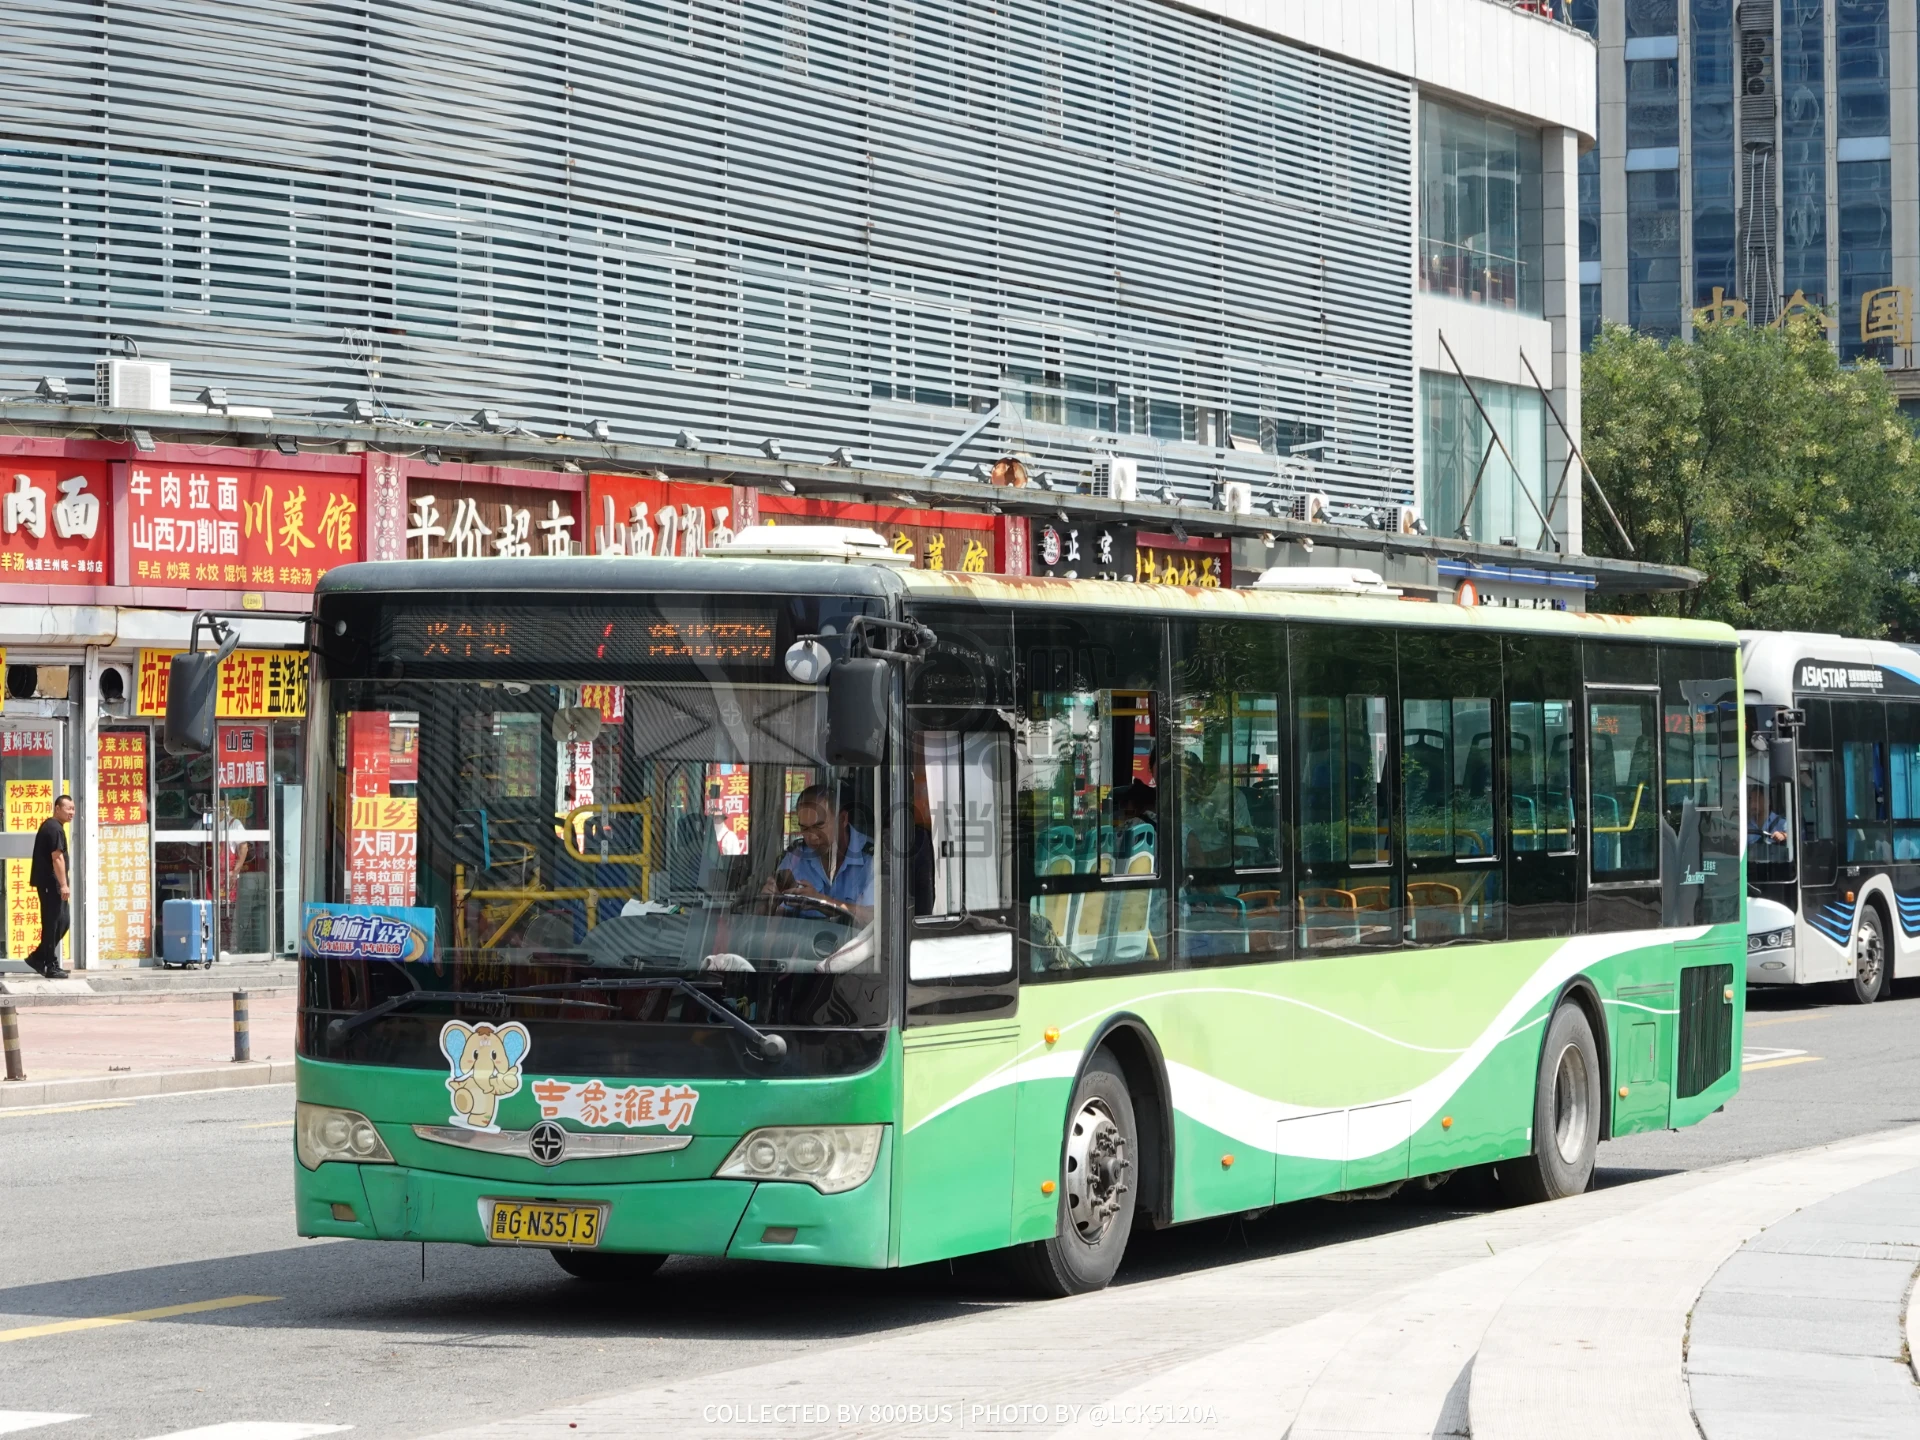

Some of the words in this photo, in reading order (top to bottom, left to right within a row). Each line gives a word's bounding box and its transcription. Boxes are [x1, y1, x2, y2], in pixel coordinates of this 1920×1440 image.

[131, 470, 239, 512] 牛肉拉面
[3, 474, 99, 539] 肉面
[243, 485, 357, 557] 川菜馆
[407, 495, 575, 559] 平价超市
[132, 515, 239, 556] 山西刀削面
[1067, 529, 1114, 564] 正宗
[1, 552, 24, 571] 羊汤
[137, 560, 161, 579] 早点
[166, 562, 190, 580] 炒菜
[196, 563, 219, 582] 水饺
[224, 564, 247, 583] 馄饨
[252, 565, 274, 584] 米线
[279, 567, 312, 585] 羊杂汤
[222, 654, 265, 714] 羊杂面
[1801, 666, 1847, 688] ASIASTAR
[3, 732, 53, 751] 黄焖鸡米饭
[226, 730, 254, 752] 山西
[218, 761, 266, 785] 大同刀削面
[98, 806, 141, 821] 羊杂汤
[353, 858, 405, 870] 手工水饺
[353, 871, 405, 882] 牛肉拉面
[353, 883, 404, 895] 羊肉面
